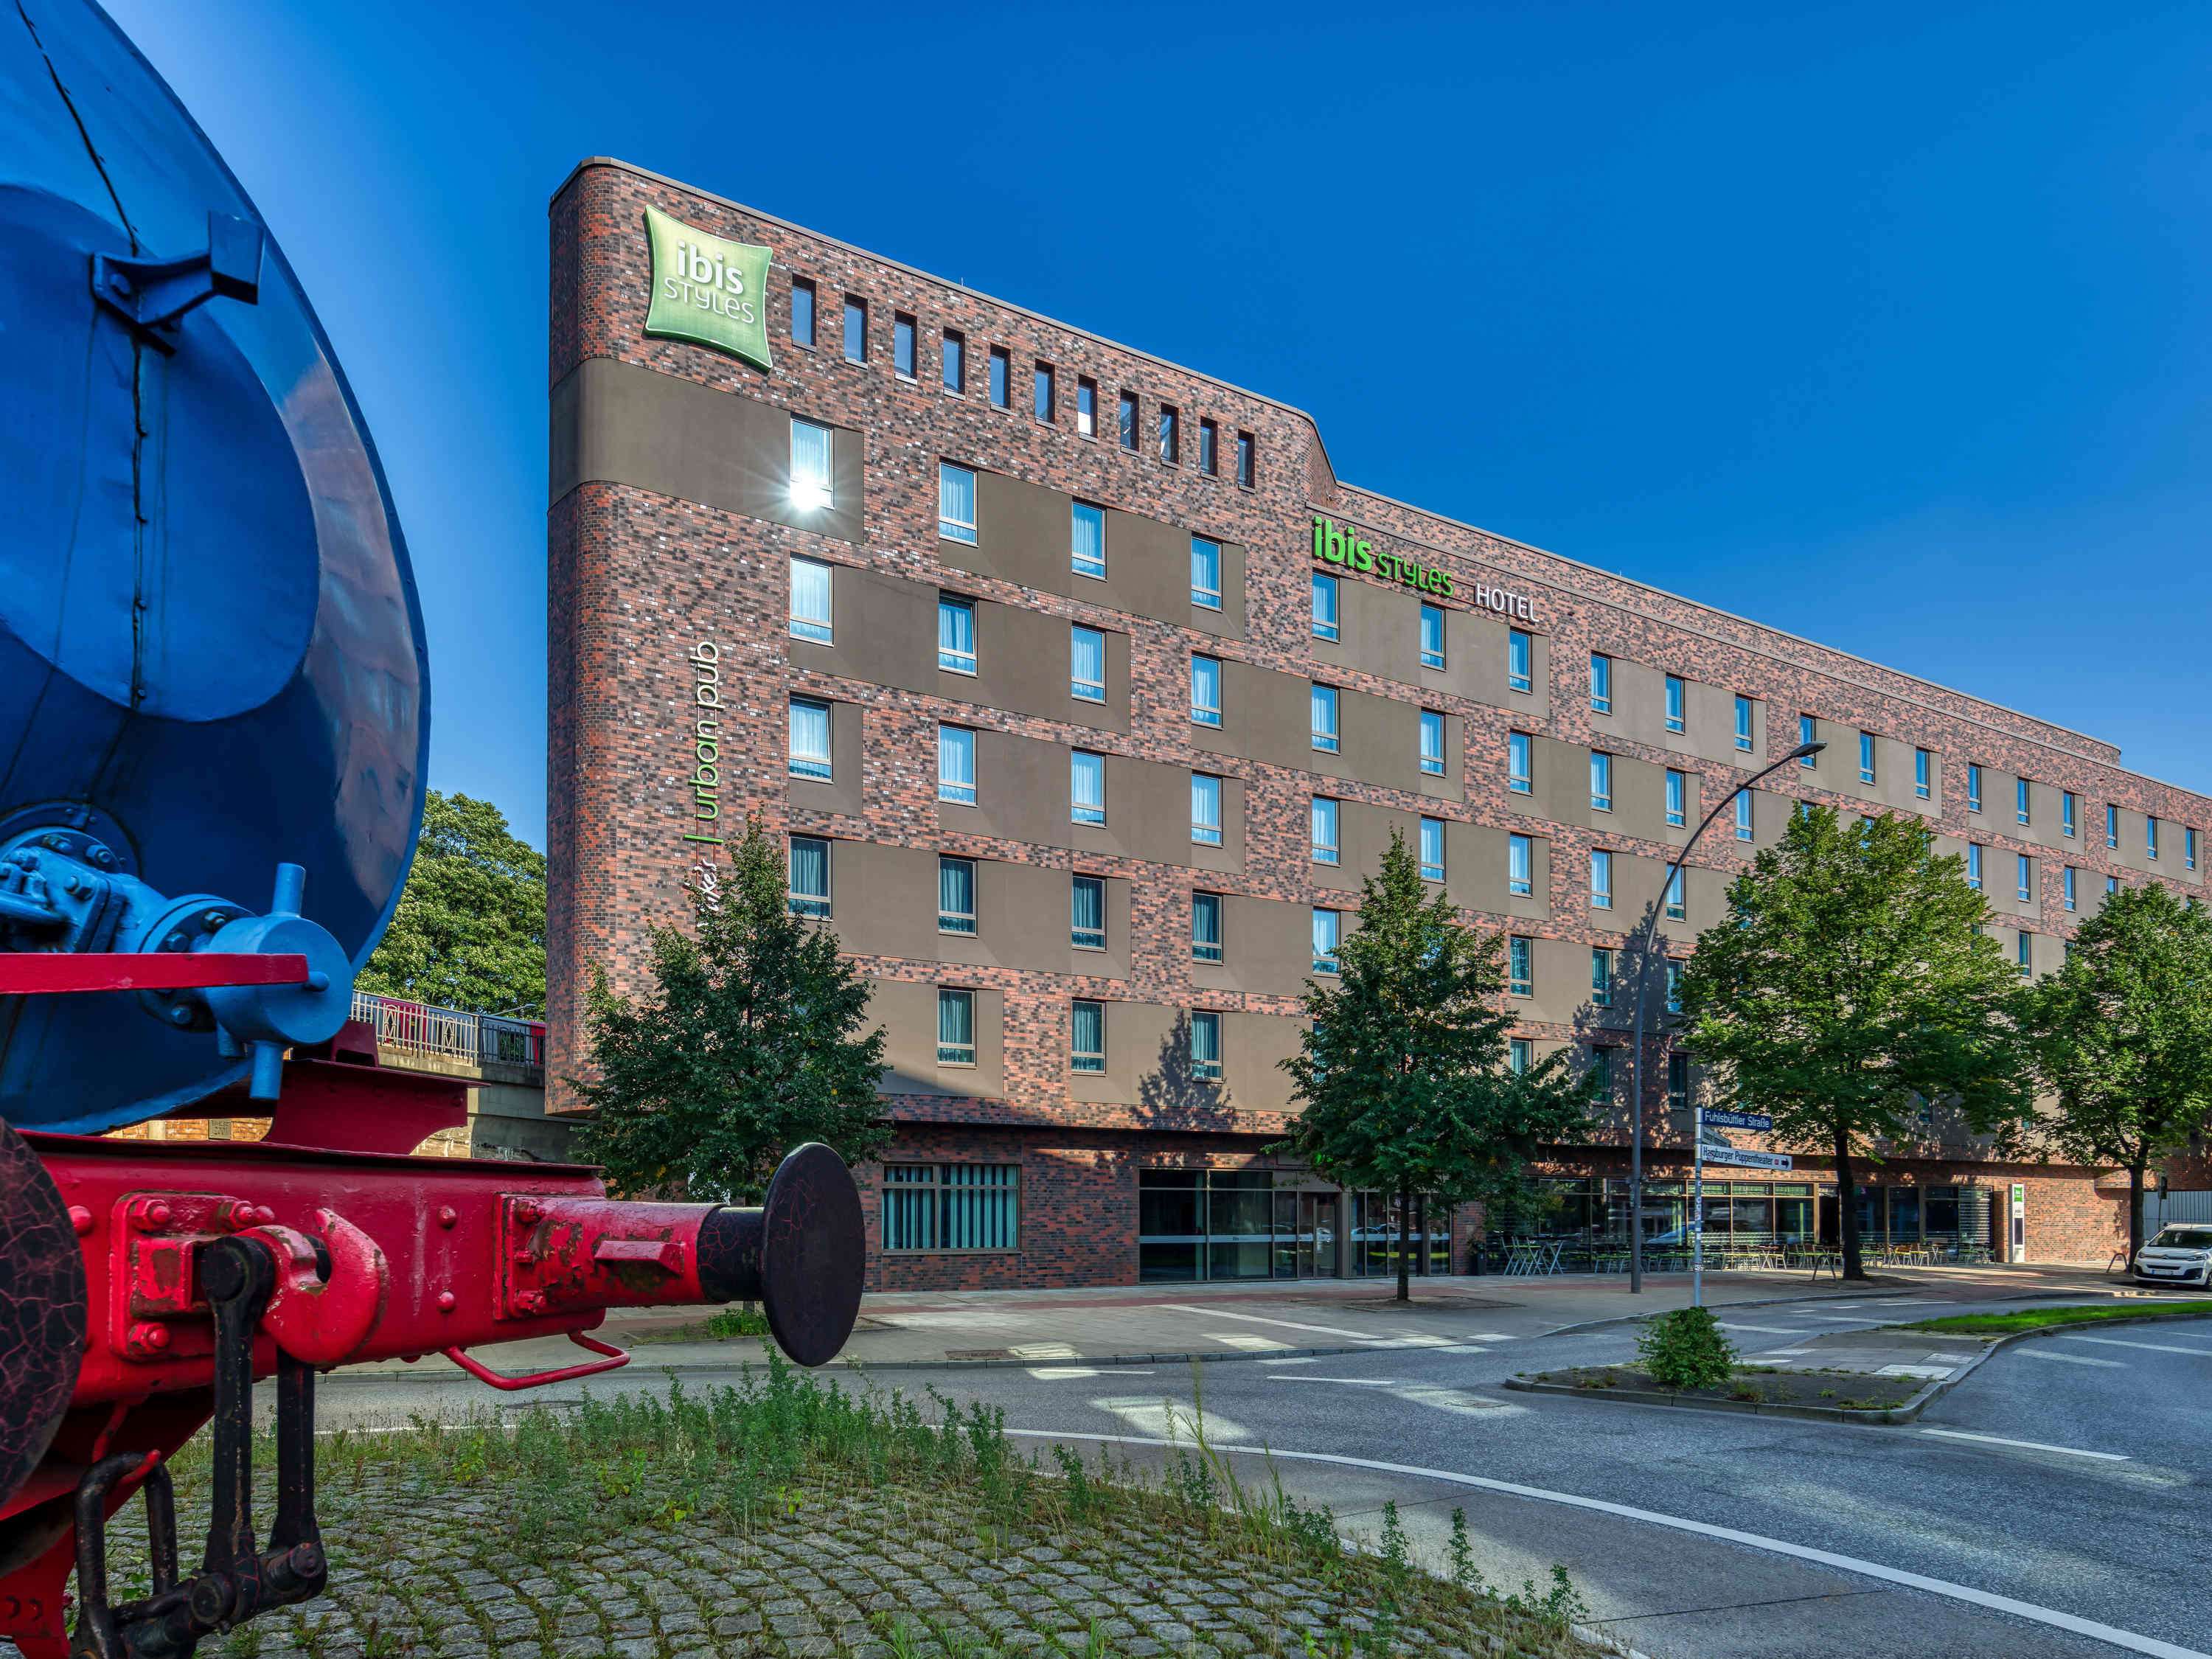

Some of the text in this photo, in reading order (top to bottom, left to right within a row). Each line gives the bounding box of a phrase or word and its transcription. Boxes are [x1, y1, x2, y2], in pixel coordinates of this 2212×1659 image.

[678, 239, 744, 295] ibis
[1312, 515, 1373, 571] ibis
[1475, 582, 1540, 623] HOTEL
[689, 641, 726, 709] pub
[688, 720, 719, 819] urban
[1705, 1110, 1770, 1128] Fuhlsbüttler Straße
[1735, 1150, 1773, 1165] Puppentheater
